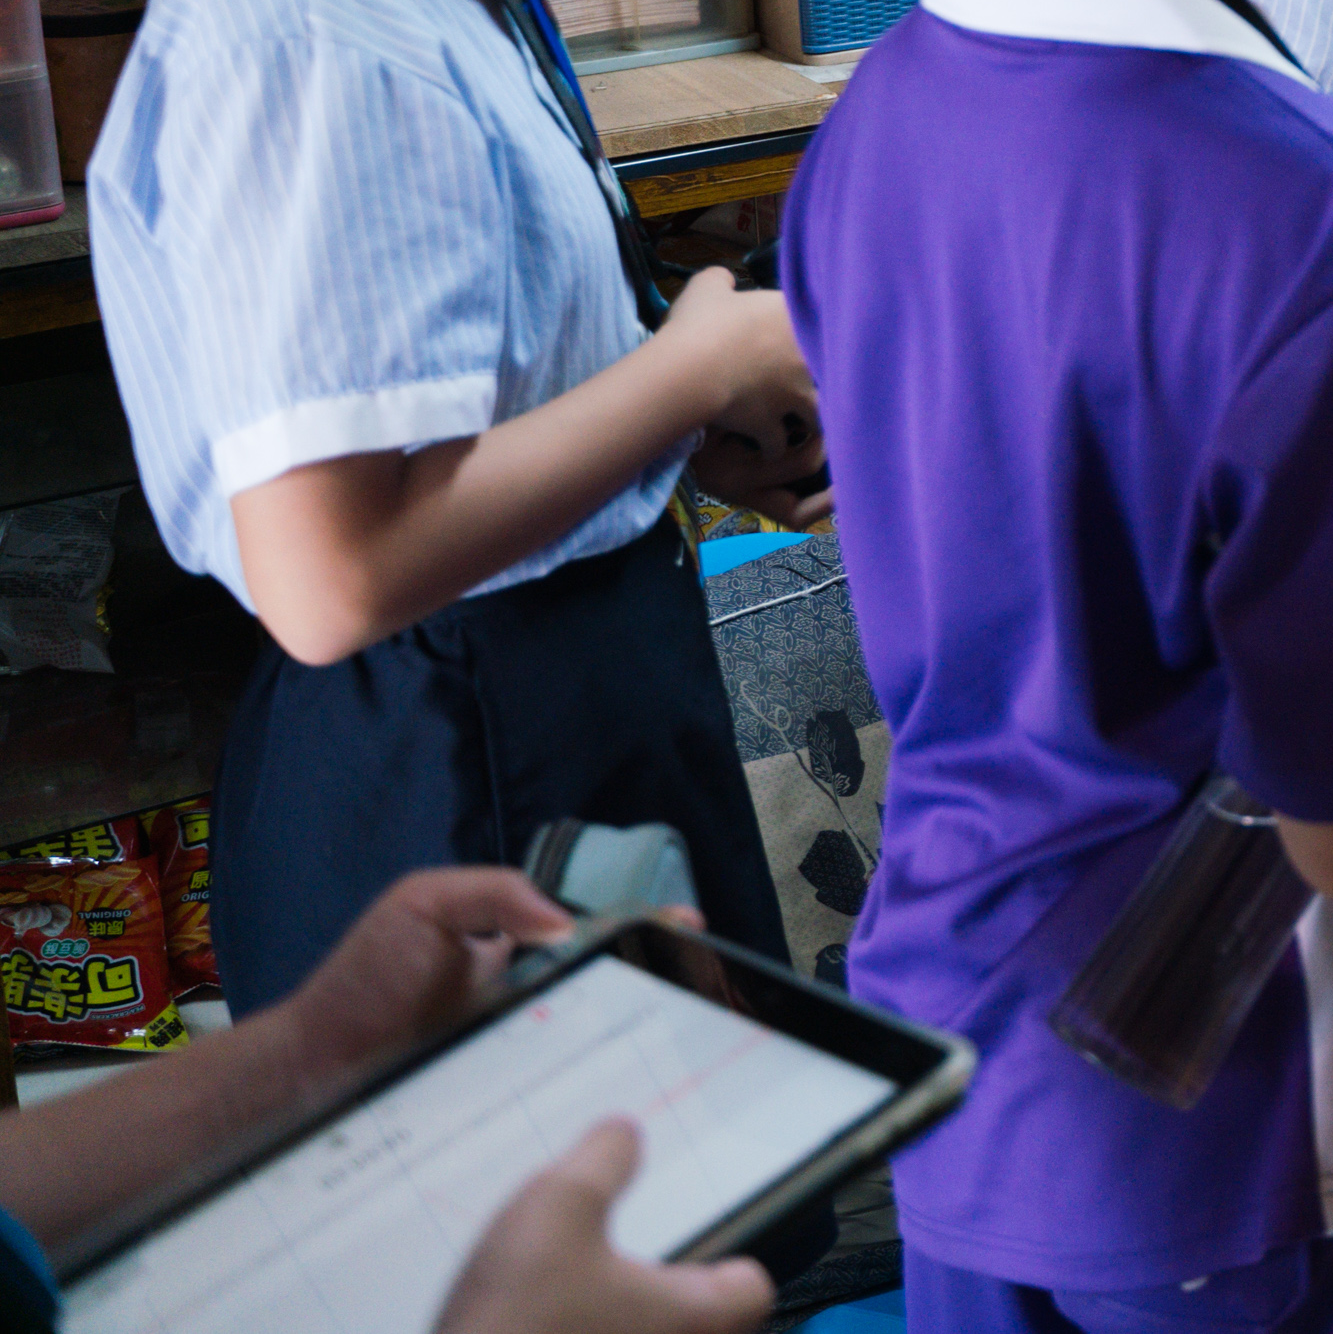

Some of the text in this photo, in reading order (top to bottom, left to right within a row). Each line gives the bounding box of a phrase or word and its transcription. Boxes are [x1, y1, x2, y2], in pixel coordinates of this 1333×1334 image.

[78, 910, 132, 920] ORIGINAL
[89, 920, 125, 937] 原味
[1, 954, 135, 1019] 可樂果
